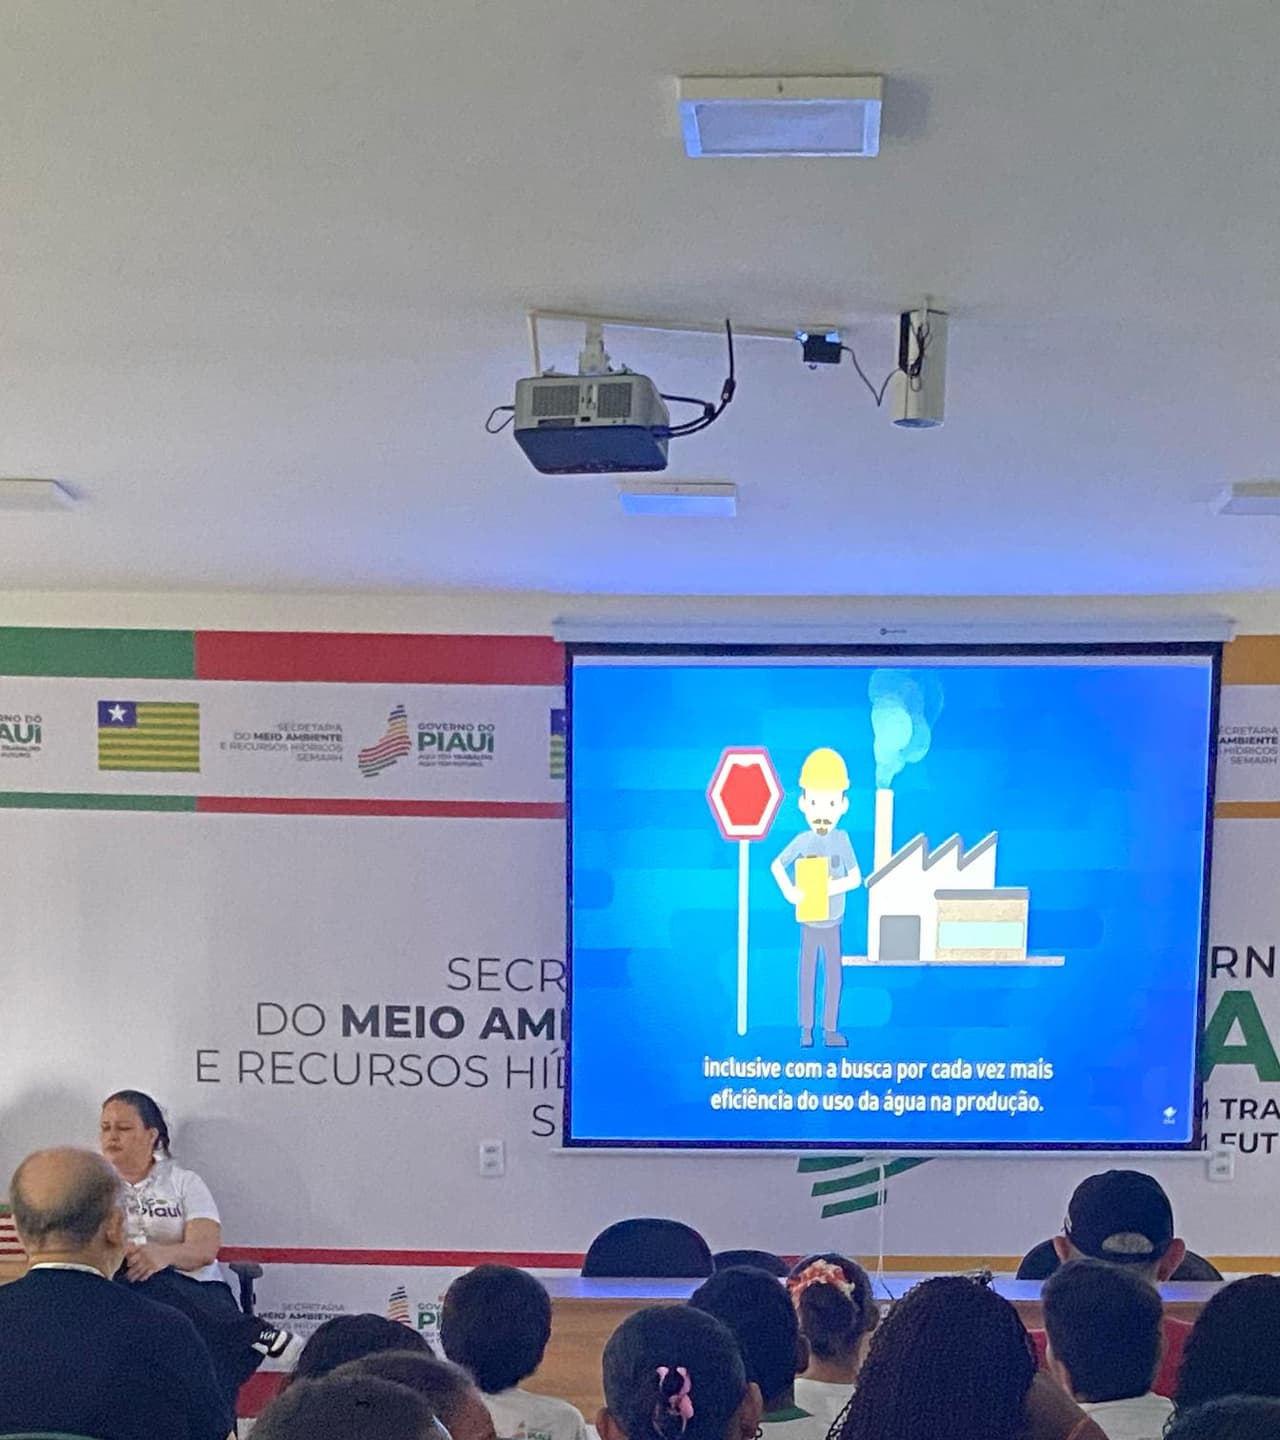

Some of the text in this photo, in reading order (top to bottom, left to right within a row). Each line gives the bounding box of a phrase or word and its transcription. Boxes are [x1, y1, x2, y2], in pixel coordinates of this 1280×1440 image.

[25, 714, 42, 723] DO
[418, 723, 495, 732] GOVERNO DO
[254, 732, 282, 741] MEIO
[286, 733, 343, 742] AMBIENTE
[1219, 736, 1278, 745] AMBIENTE
[257, 1002, 326, 1037] DO
[341, 1004, 466, 1040] MEIO
[196, 1049, 221, 1083] E
[237, 1050, 489, 1089] RECURSOS
[704, 1055, 1054, 1084] inclusive com a busca por cada vez mais
[710, 1087, 1044, 1117] eficiência do uso da água na produção.
